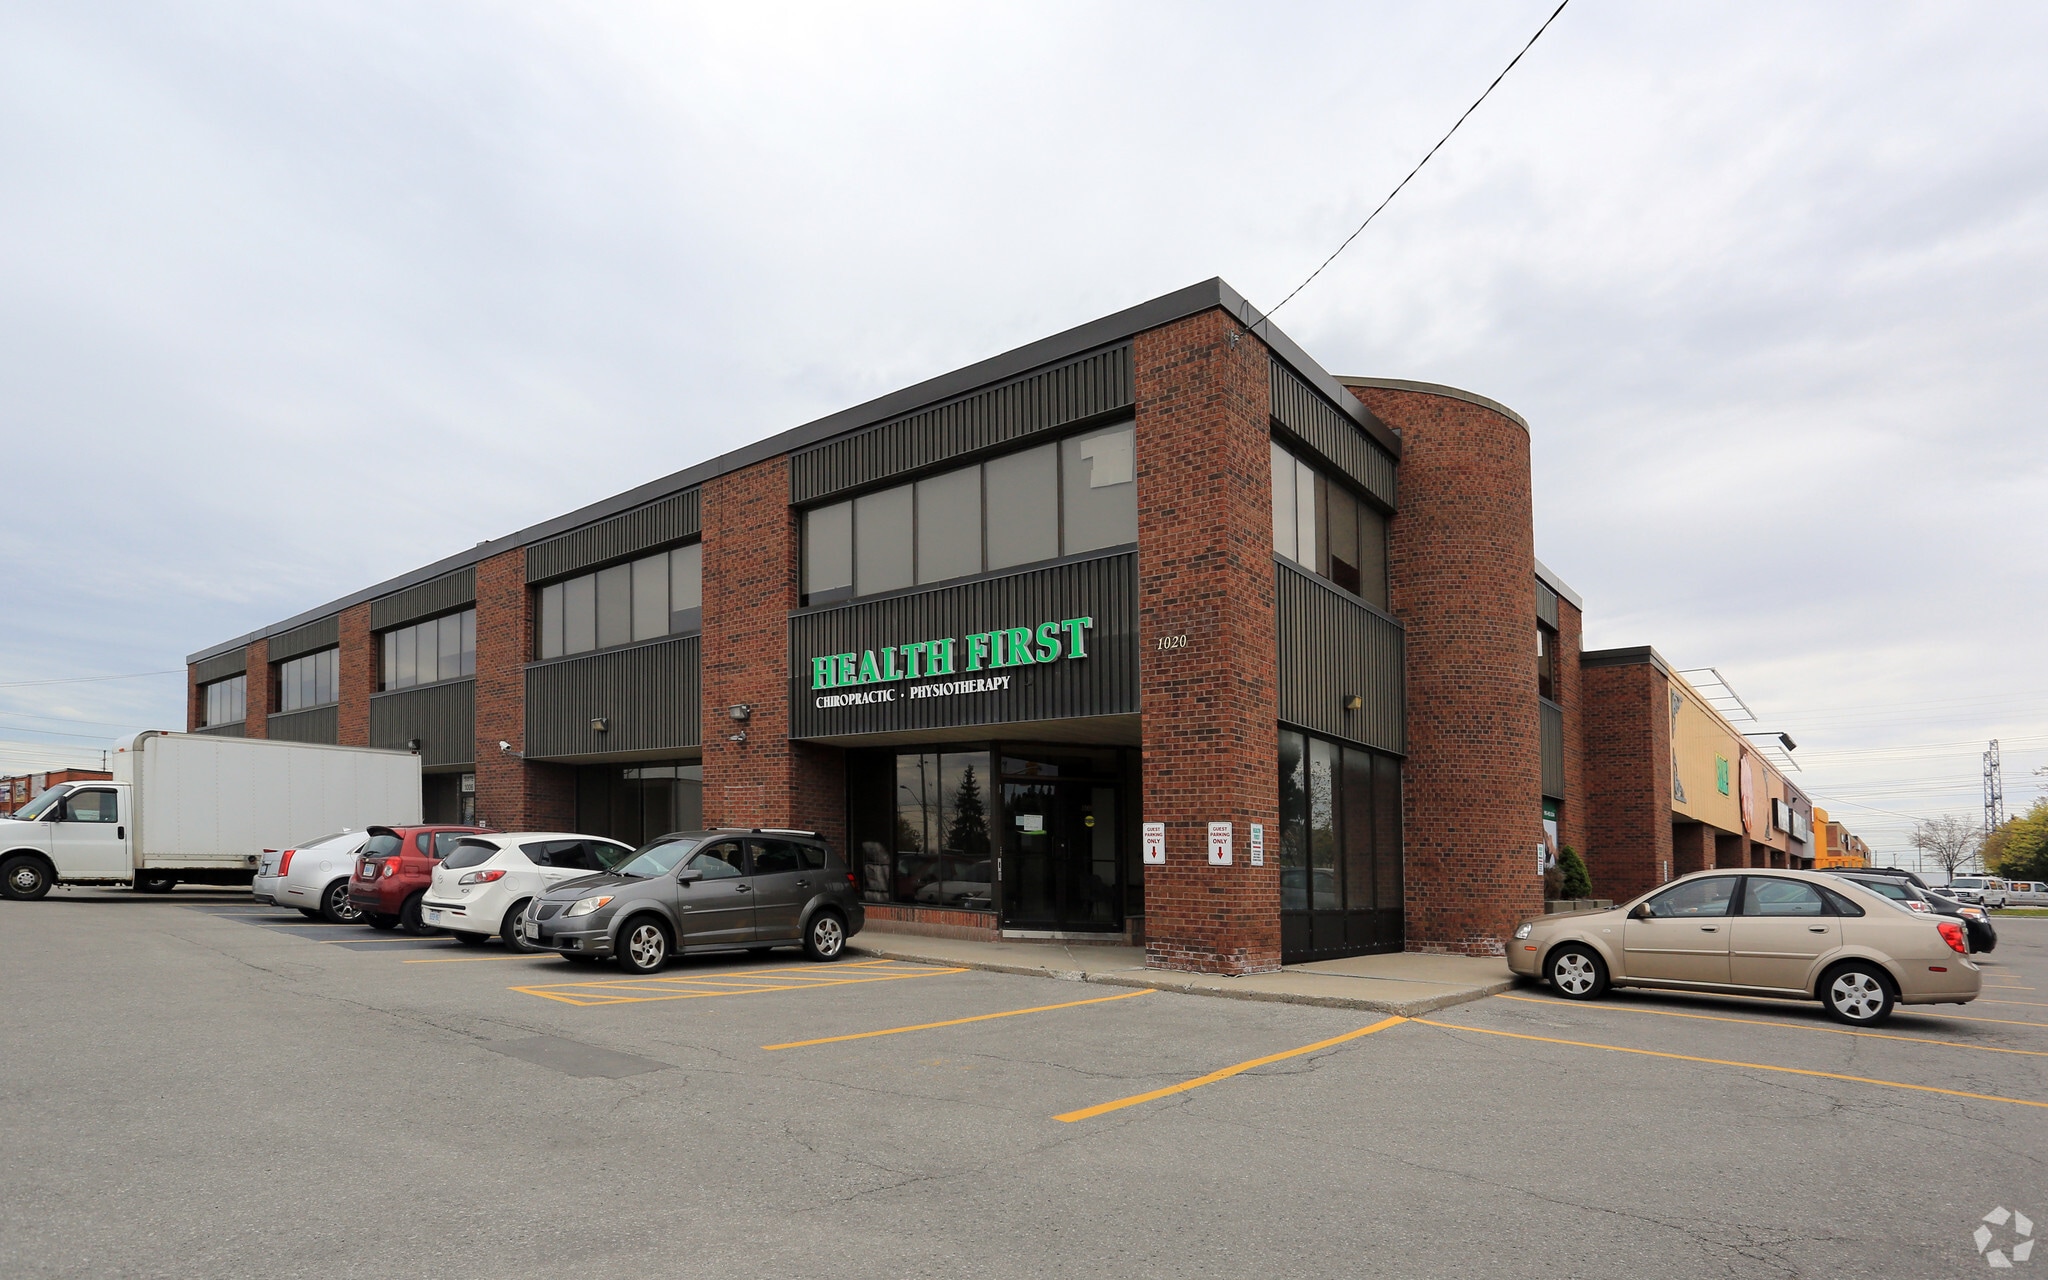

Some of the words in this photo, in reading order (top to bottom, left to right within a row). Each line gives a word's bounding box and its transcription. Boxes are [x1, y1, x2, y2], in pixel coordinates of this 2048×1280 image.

[811, 637, 956, 691] HEALTH
[966, 616, 1093, 671] FIRST
[1158, 634, 1187, 650] 1020
[815, 688, 896, 709] CHIROPRACTIC
[909, 675, 1011, 700] PHYSIOTHERAPY
